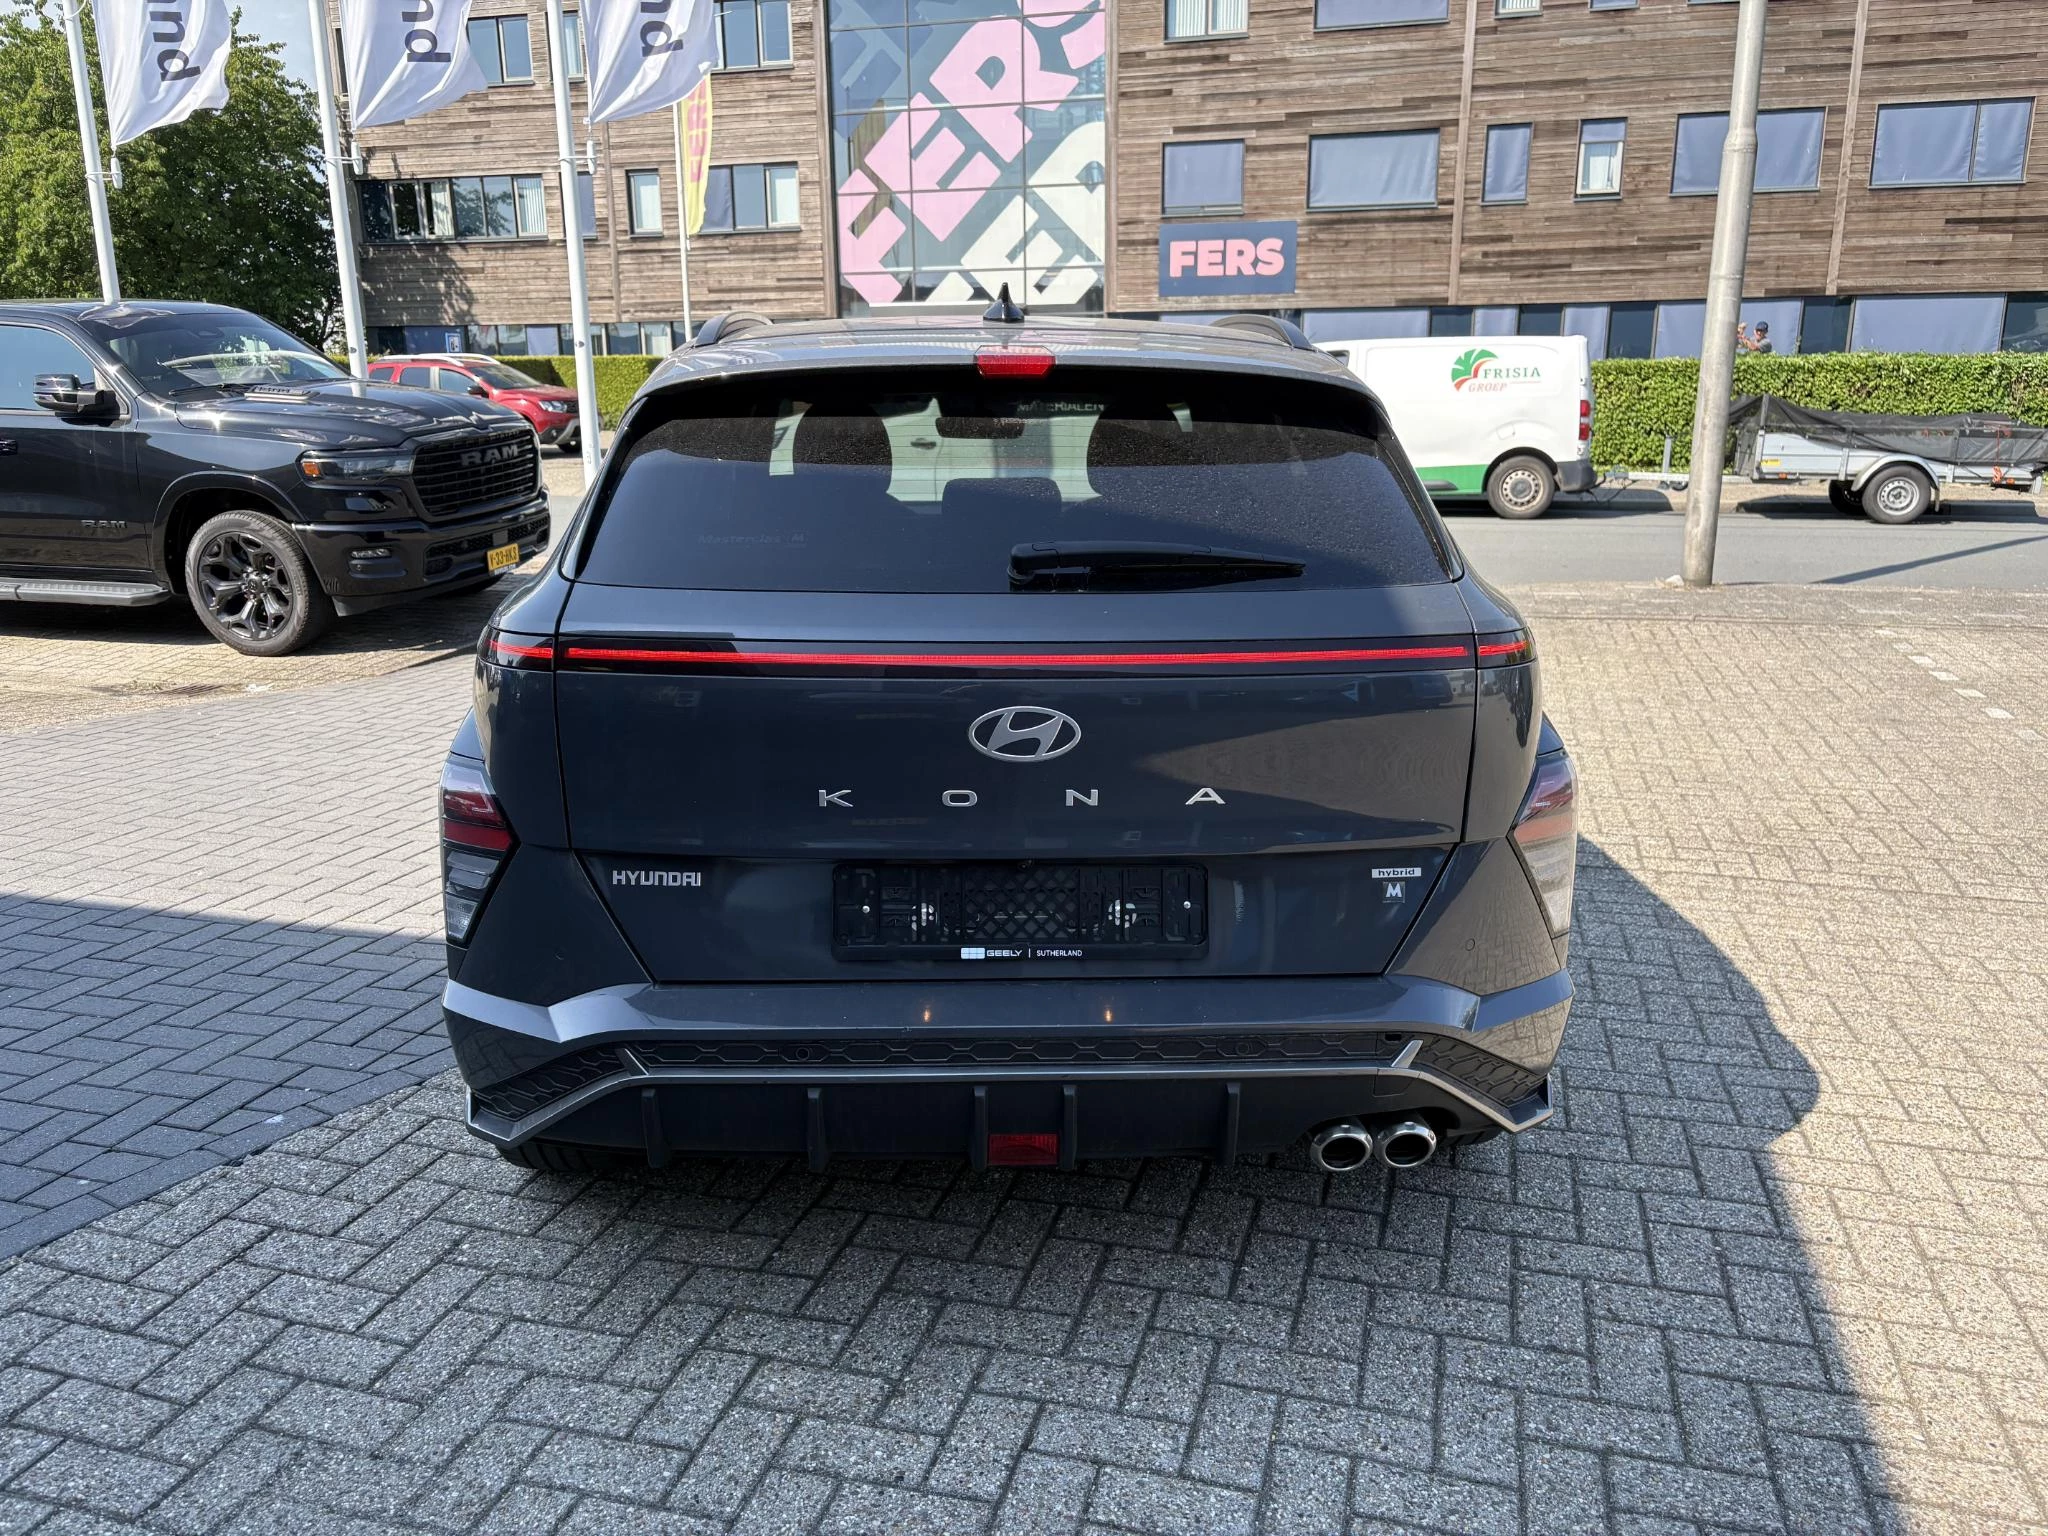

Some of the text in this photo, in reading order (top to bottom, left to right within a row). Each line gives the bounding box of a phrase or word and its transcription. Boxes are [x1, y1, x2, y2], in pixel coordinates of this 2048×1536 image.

[147, 0, 200, 81] nd
[1169, 237, 1285, 277] FERS
[1484, 367, 1541, 379] FRISIA
[1468, 382, 1507, 393] GROEP
[461, 444, 520, 466] RAM
[612, 870, 701, 887] HYUNDAI
[1378, 868, 1415, 877] hybrid
[1385, 882, 1403, 898] M
[986, 949, 1083, 957] GEELY SUTHERLAND
